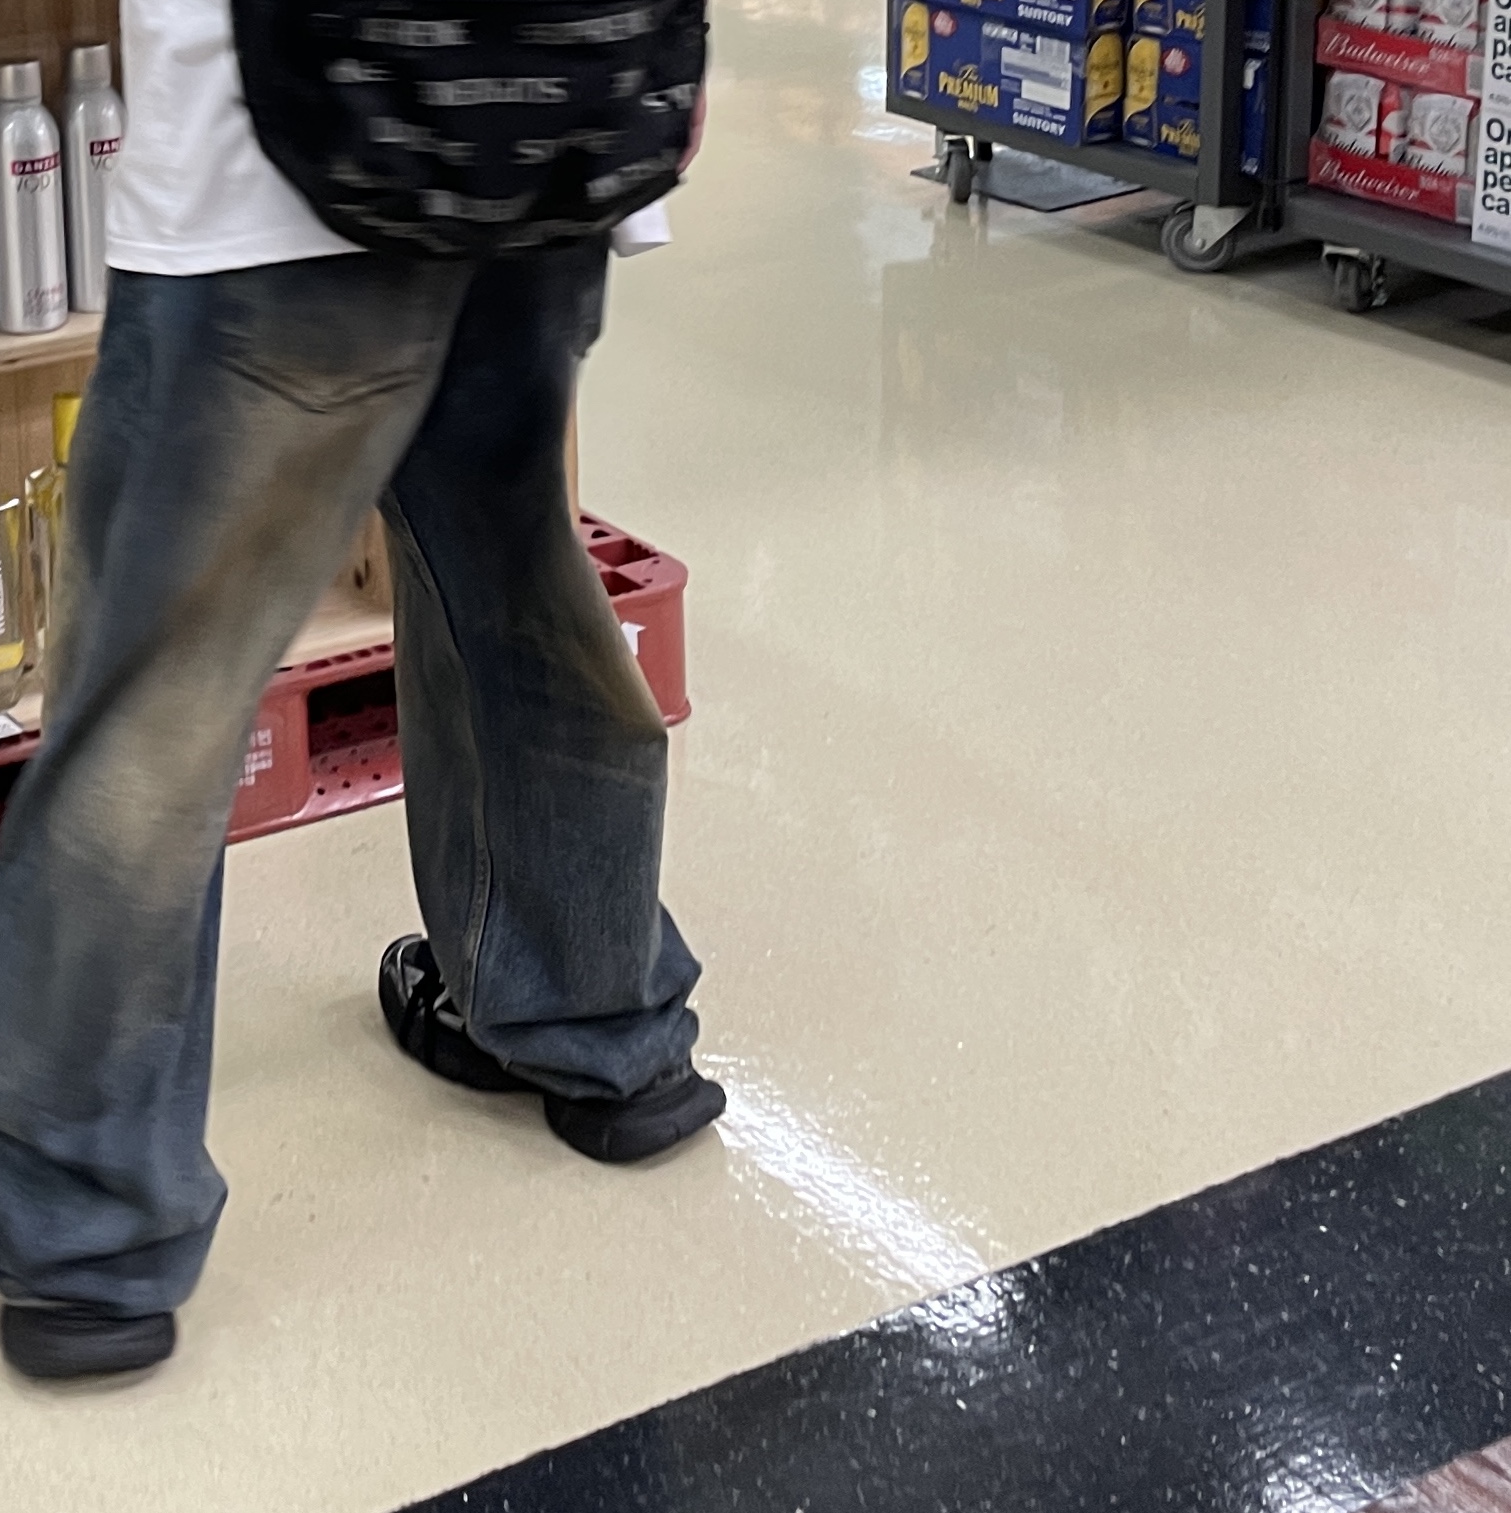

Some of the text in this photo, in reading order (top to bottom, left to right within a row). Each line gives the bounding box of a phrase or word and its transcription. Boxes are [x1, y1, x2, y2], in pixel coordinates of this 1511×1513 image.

[1017, 3, 1074, 28] SUNTORY
[1324, 31, 1434, 76] Budweiser
[938, 71, 1000, 108] PREMIUM
[1012, 111, 1067, 137] SUNTORY
[1317, 152, 1423, 201] Budweiser
